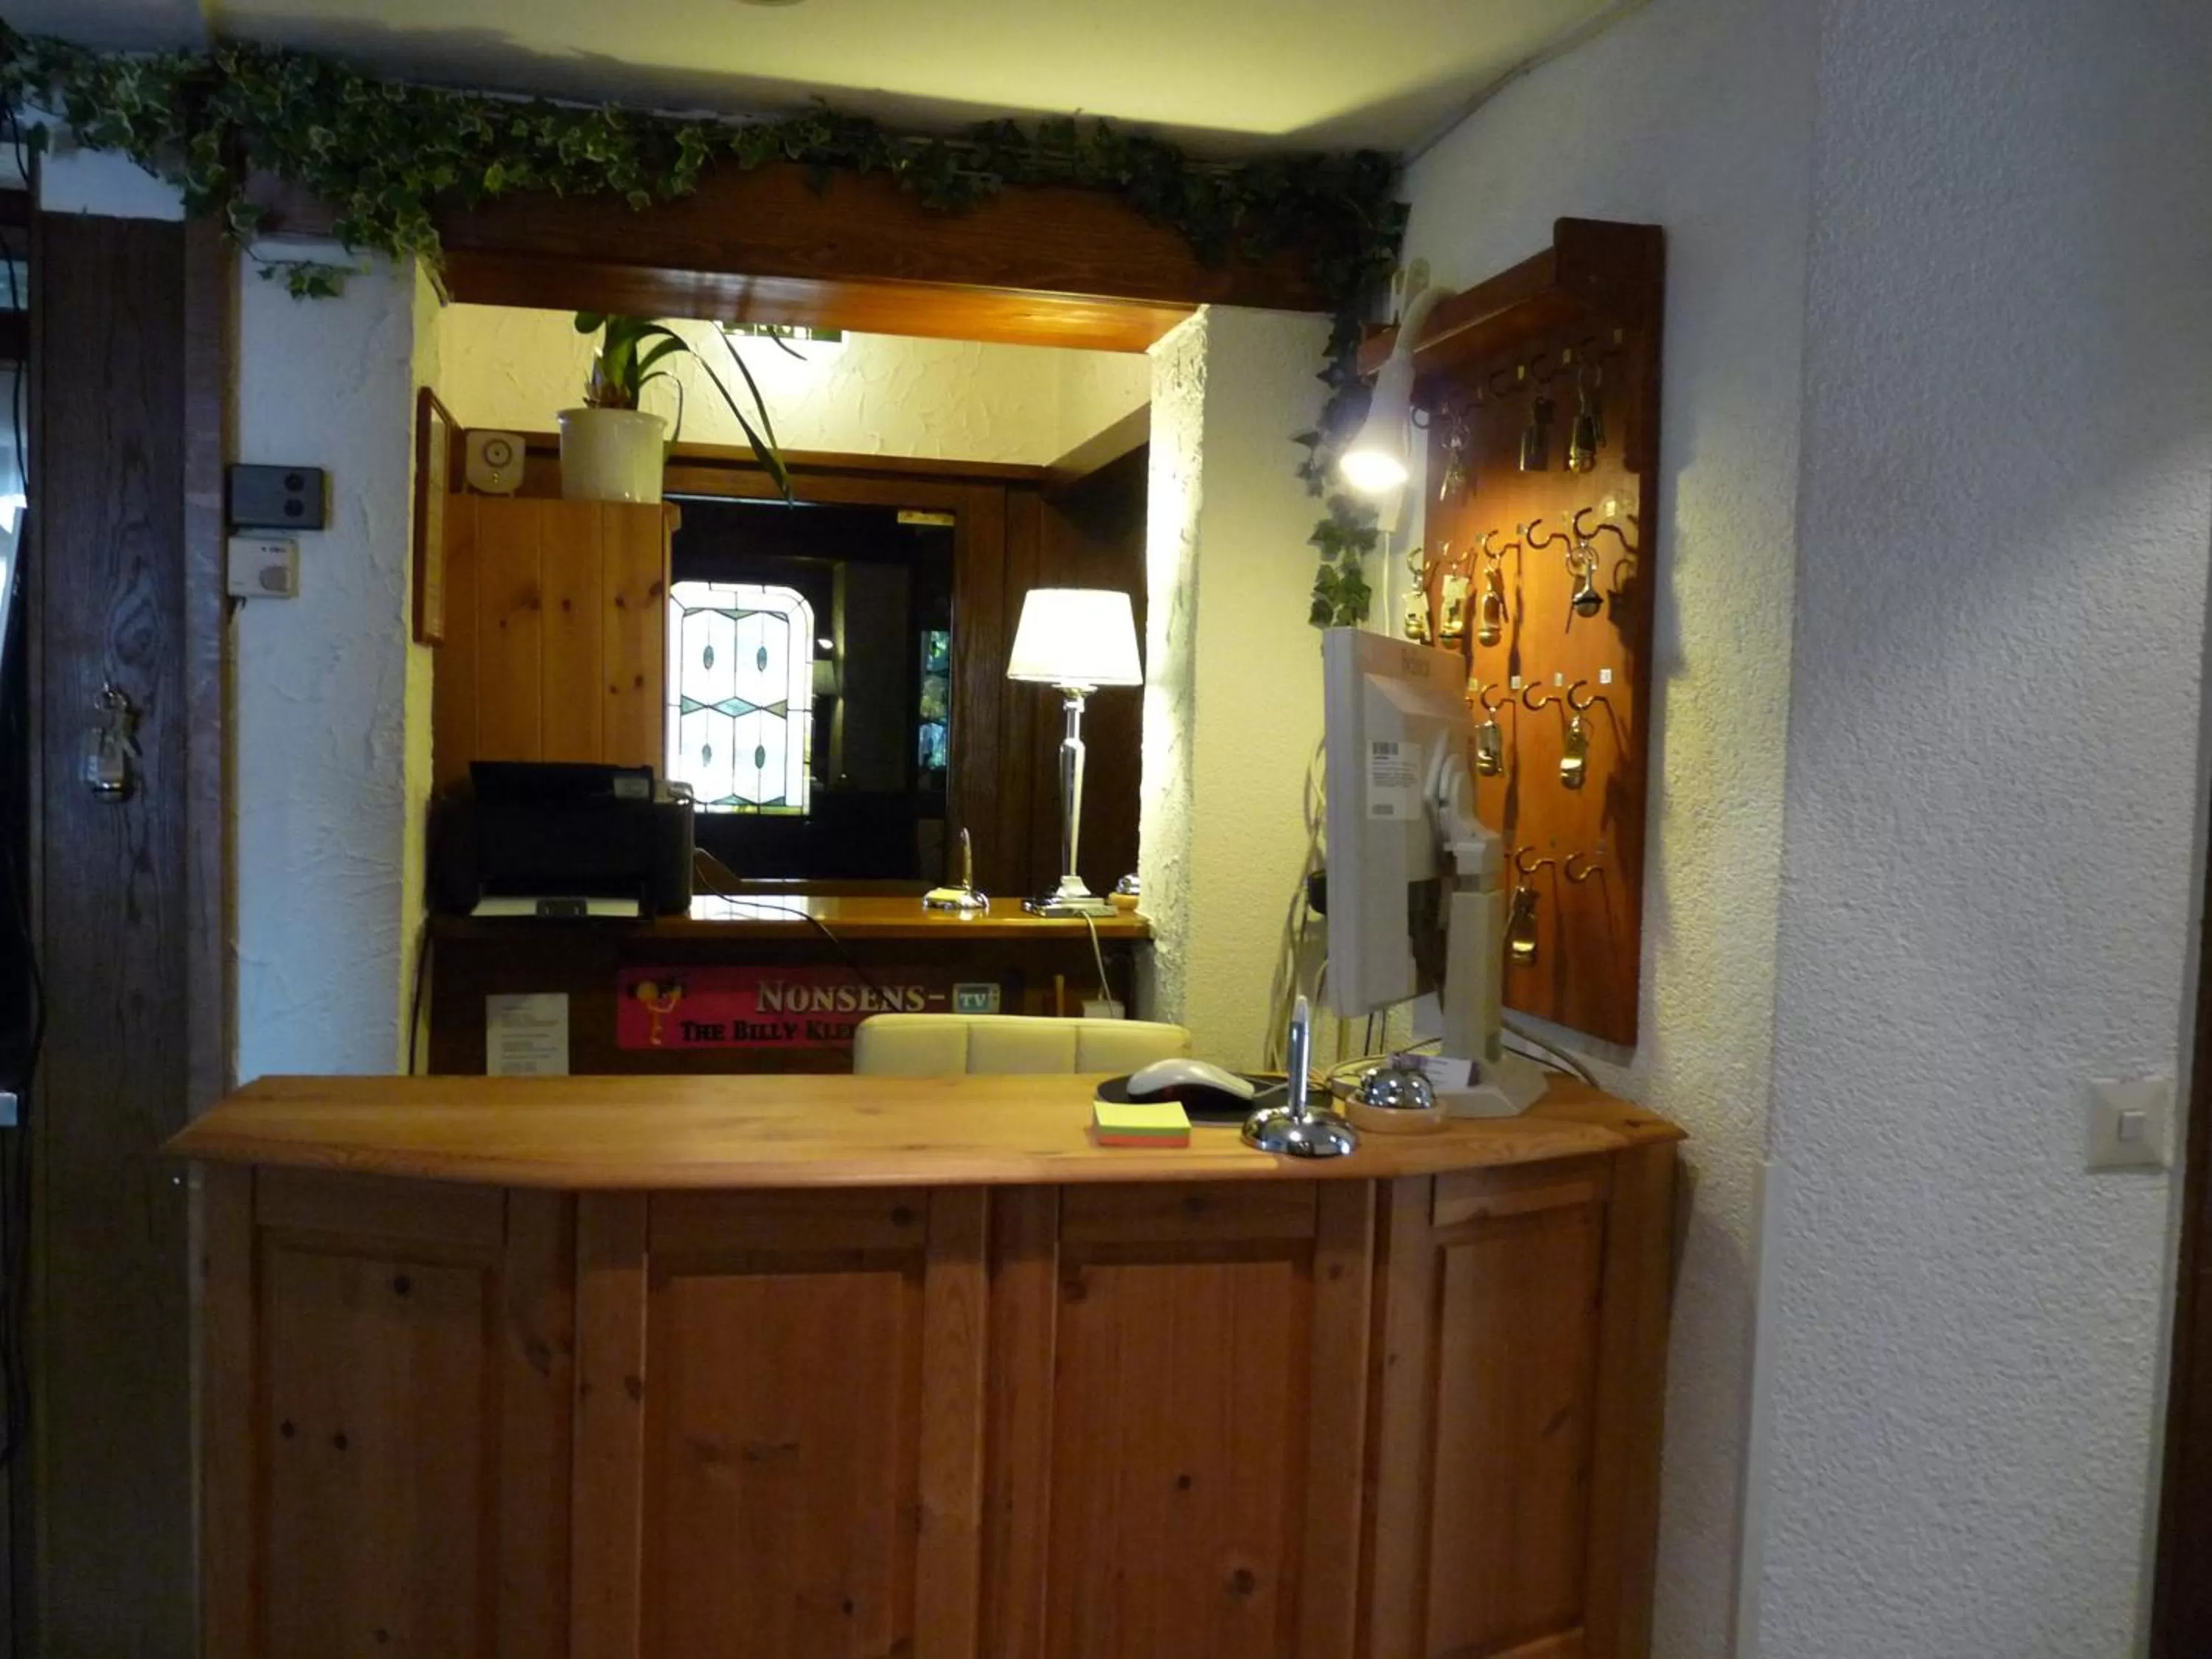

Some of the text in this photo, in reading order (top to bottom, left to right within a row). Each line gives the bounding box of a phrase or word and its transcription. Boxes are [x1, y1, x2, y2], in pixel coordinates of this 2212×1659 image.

[959, 992, 987, 1007] TV
[681, 1020, 726, 1040] THE
[734, 1020, 797, 1040] BILLY
